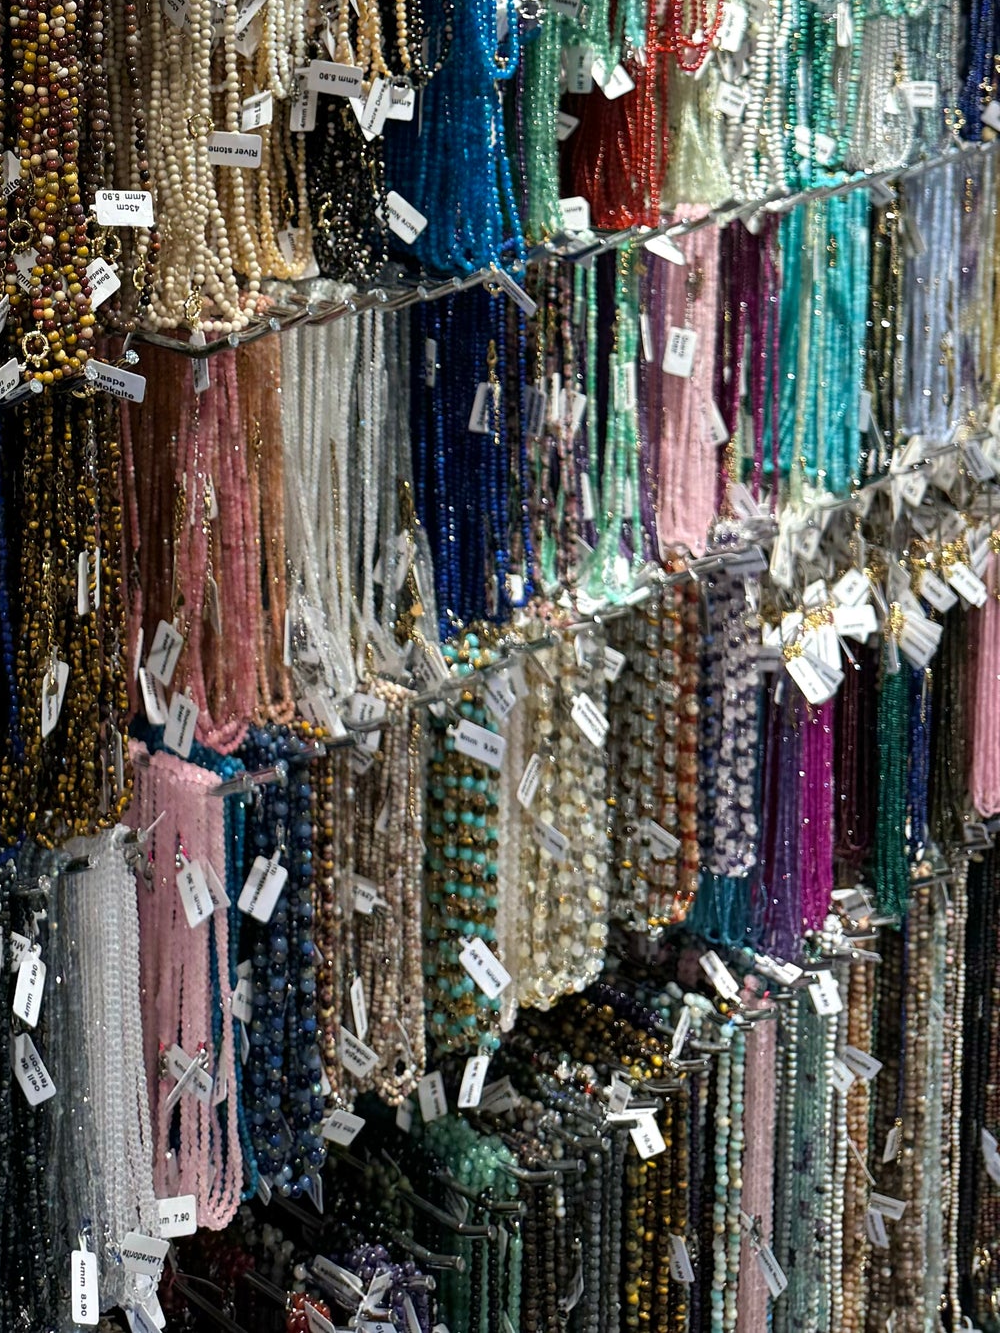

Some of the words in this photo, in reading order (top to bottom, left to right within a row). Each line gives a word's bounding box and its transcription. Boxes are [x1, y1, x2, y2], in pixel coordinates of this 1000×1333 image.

[338, 75, 360, 85] 4mm
[207, 145, 234, 154] stone
[236, 147, 259, 158] River
[101, 192, 120, 202] 5.90
[124, 192, 147, 202] 4mm
[116, 203, 140, 212] 43cm
[92, 381, 134, 401] Mokaite
[174, 1212, 191, 1224] 7.90
[121, 1249, 163, 1266] Labradorite
[79, 1260, 87, 1287] 4mm
[79, 1294, 87, 1316] 8.90
